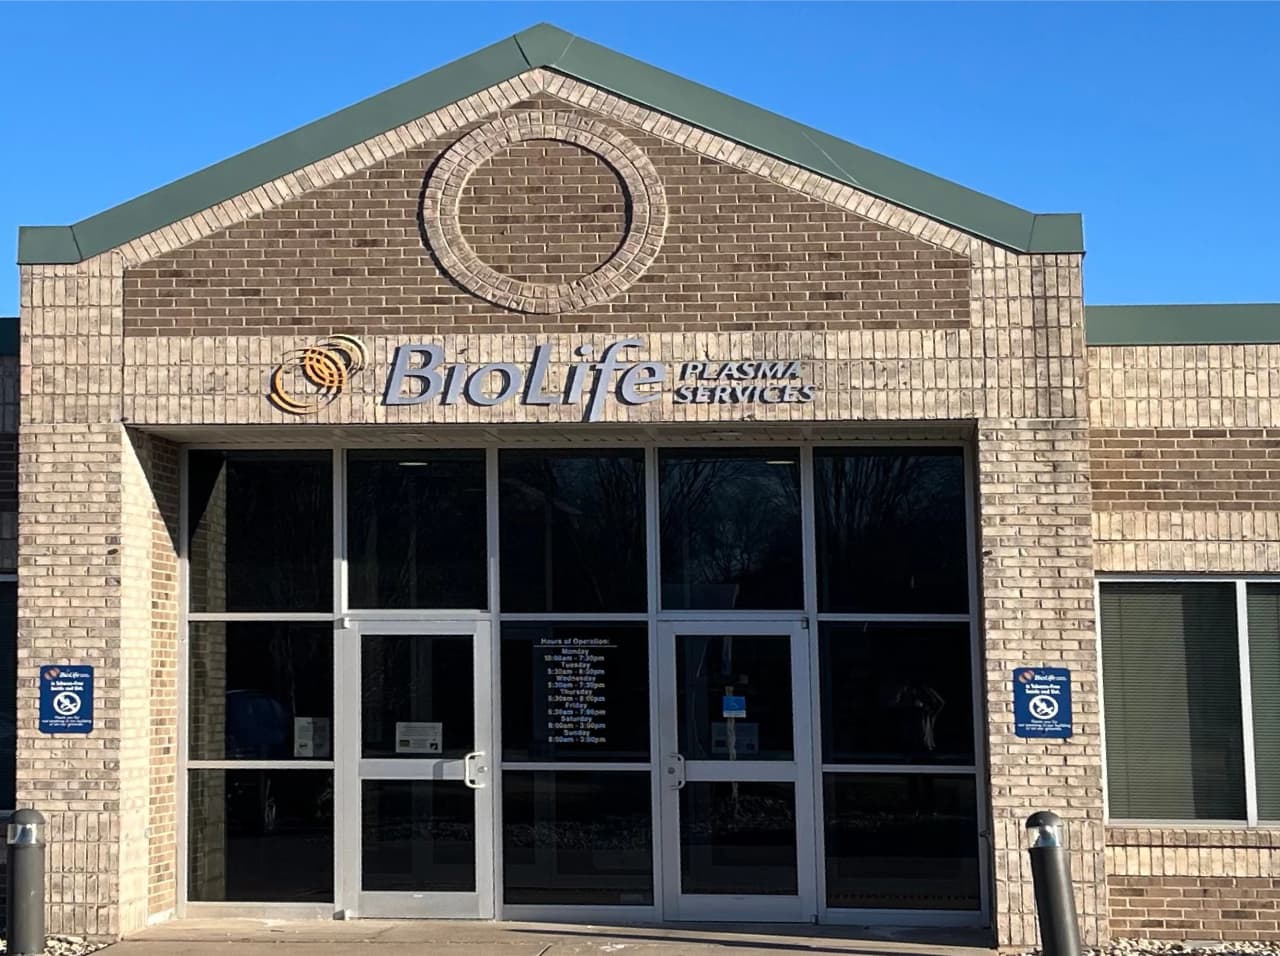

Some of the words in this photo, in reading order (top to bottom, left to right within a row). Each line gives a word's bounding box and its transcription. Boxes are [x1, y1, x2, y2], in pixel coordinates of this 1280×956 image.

[679, 361, 801, 380] PLASMA
[382, 339, 666, 423] BioLife
[673, 384, 816, 404] SERVICES
[561, 648, 589, 656] Monday
